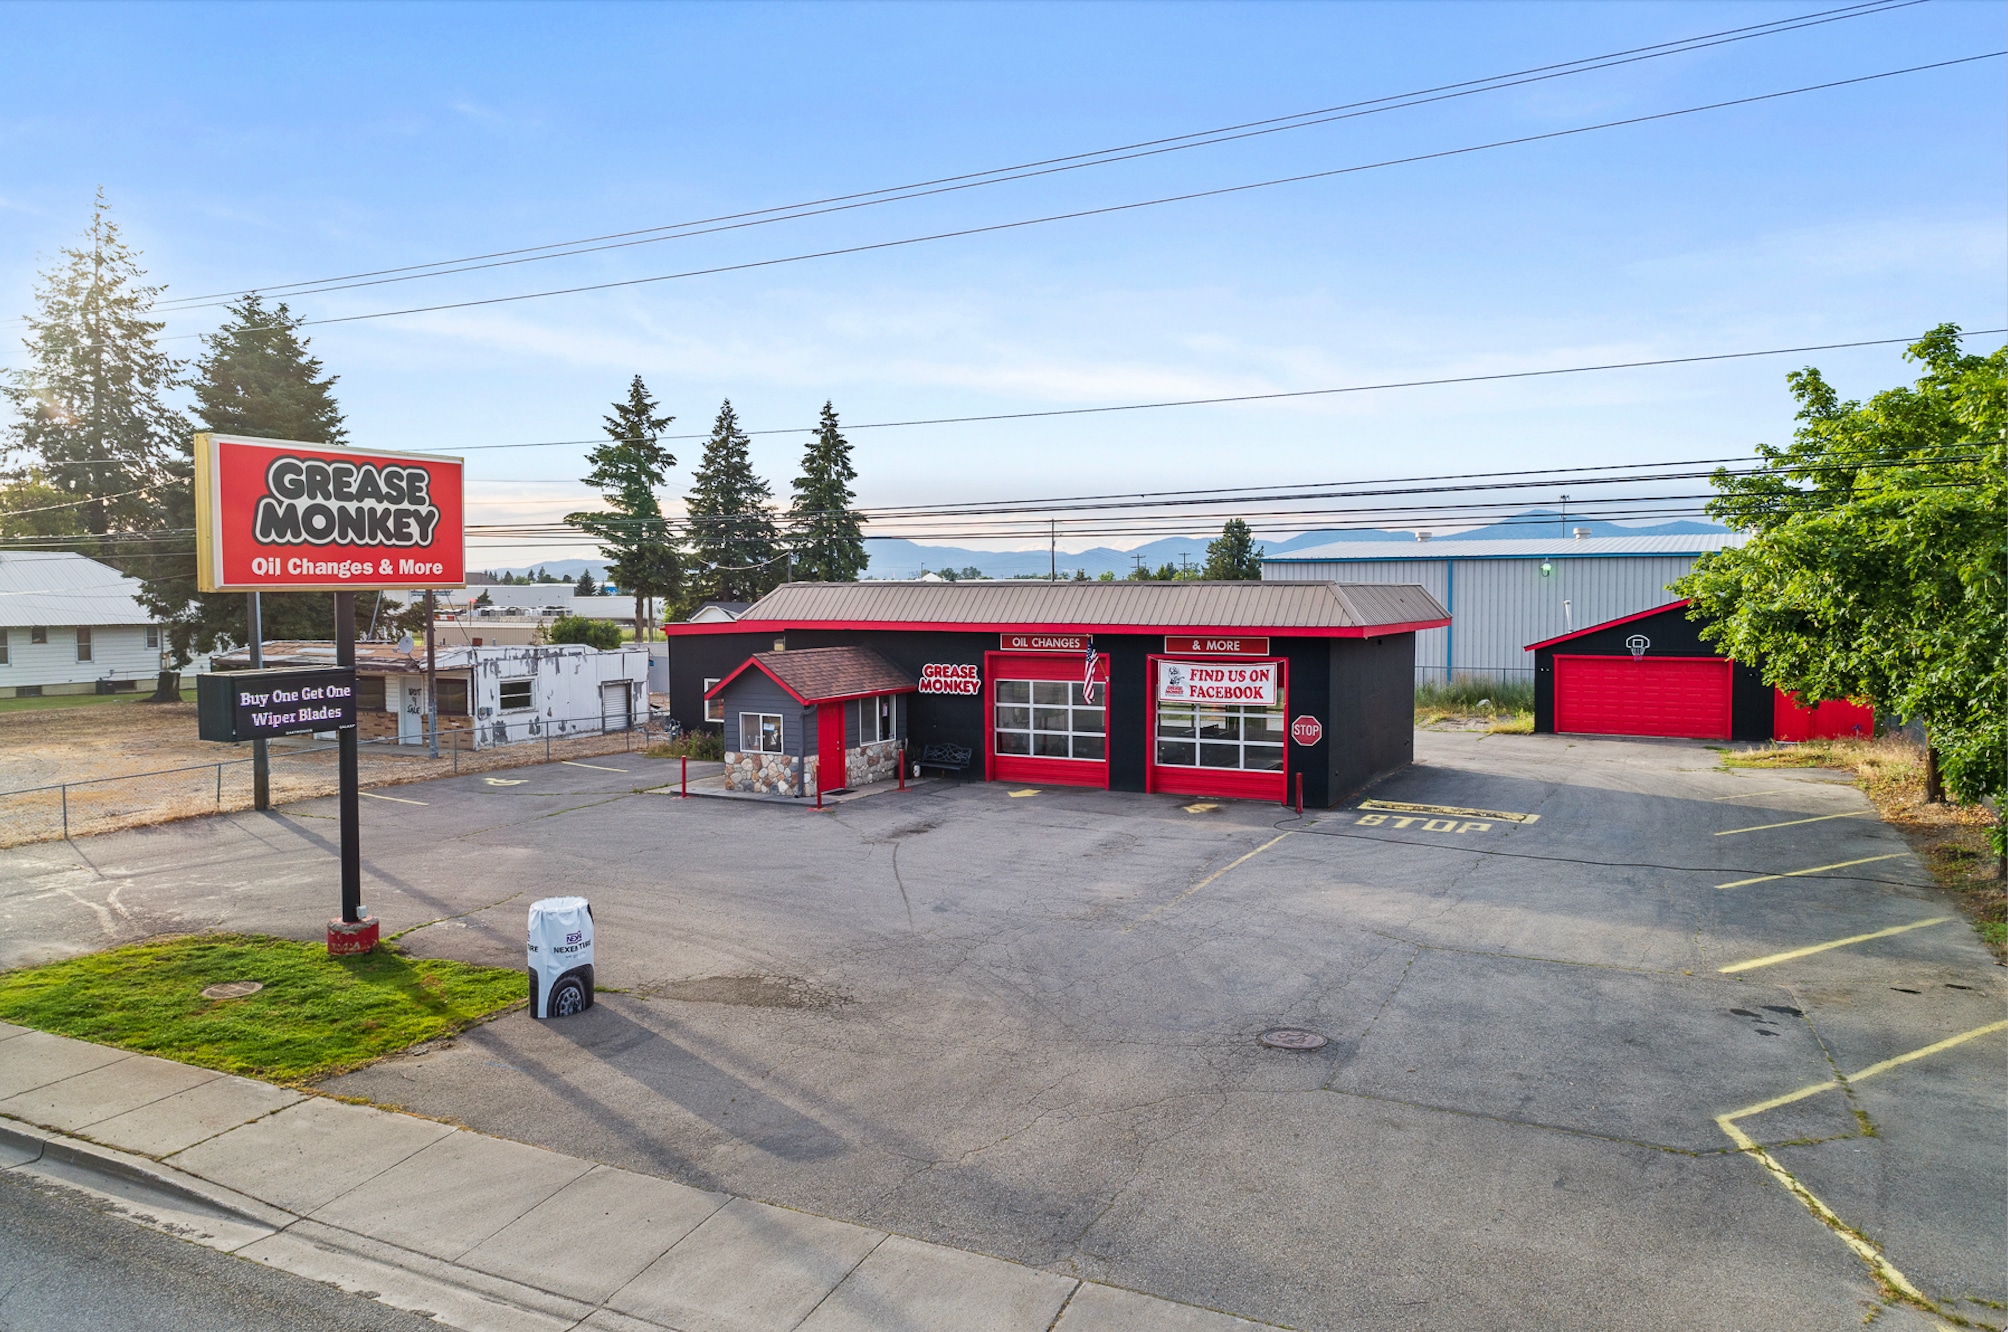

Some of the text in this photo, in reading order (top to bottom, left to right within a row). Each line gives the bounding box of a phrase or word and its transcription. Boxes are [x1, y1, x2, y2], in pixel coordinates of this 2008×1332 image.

[268, 460, 429, 506] GREASE
[258, 500, 437, 544] MONKEY
[252, 558, 443, 579] Oil Changes & More
[1012, 637, 1081, 648] OIL CHANGES
[1192, 640, 1240, 651] & MORE
[923, 664, 977, 679] GREASE
[1189, 669, 1271, 682] FIND US ON
[919, 678, 981, 694] MONKEY
[1189, 685, 1264, 699] FACEBOOK
[240, 685, 351, 707] Buy One Get One
[252, 705, 342, 728] Wiper Blades
[407, 704, 420, 715] SALE
[1294, 724, 1319, 736] STOP
[1354, 814, 1493, 834] STOP
